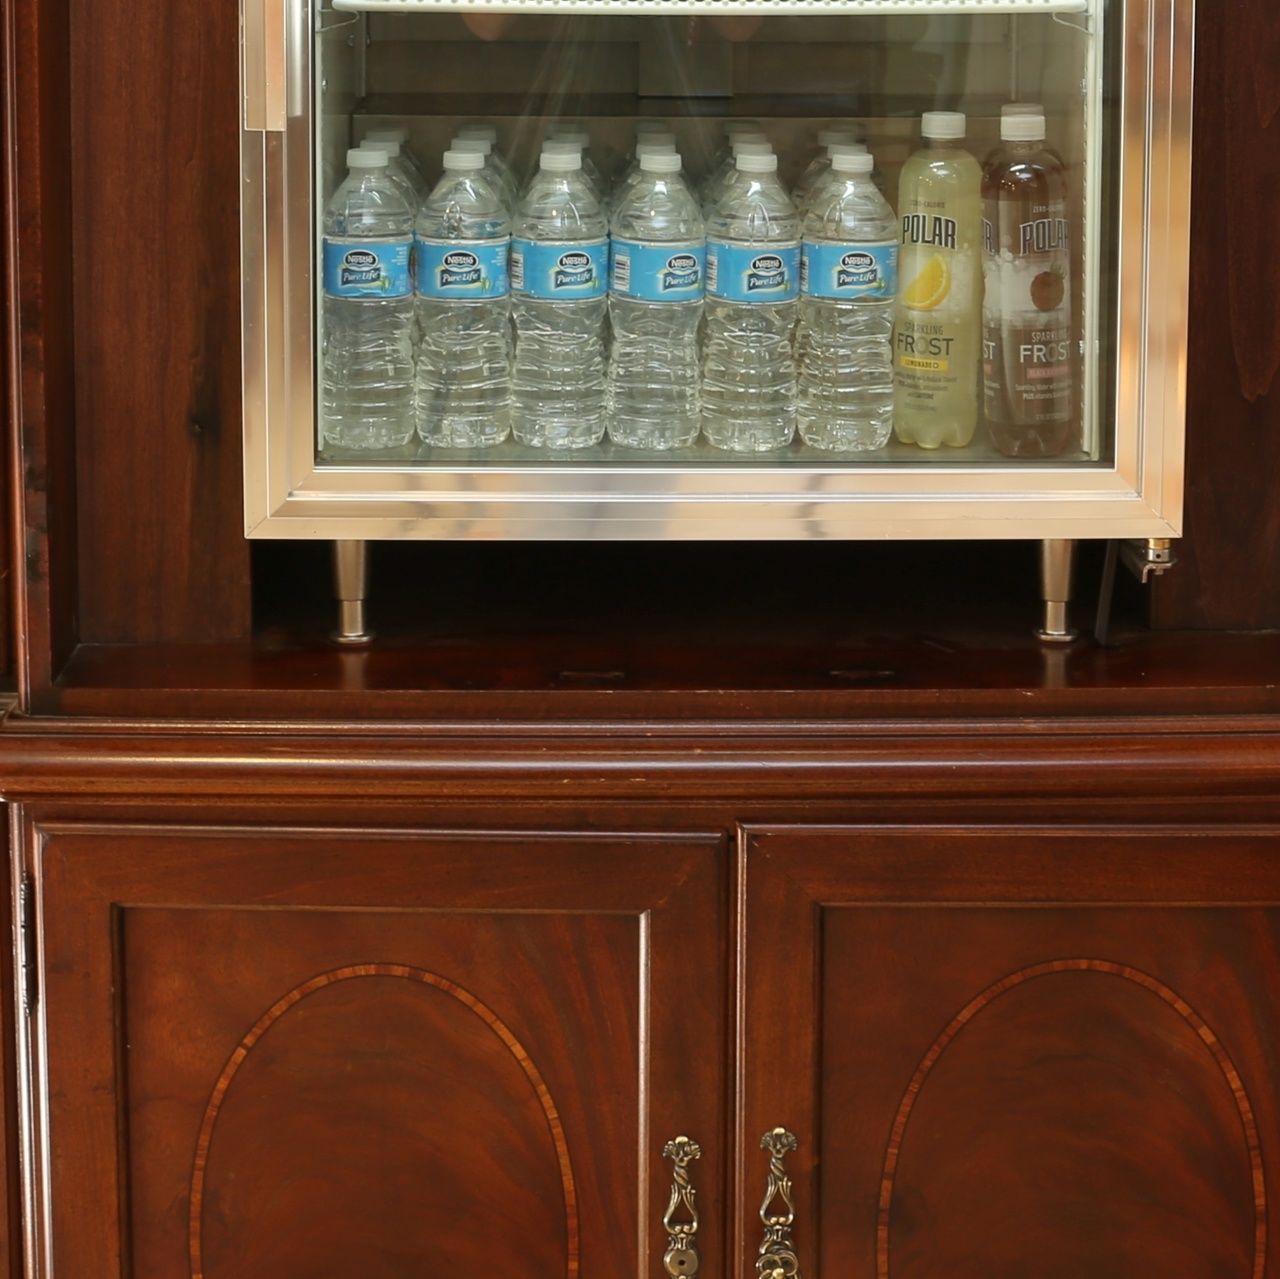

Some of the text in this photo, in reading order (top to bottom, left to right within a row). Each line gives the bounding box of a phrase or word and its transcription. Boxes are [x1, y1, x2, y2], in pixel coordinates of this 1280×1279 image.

[901, 213, 957, 250] POLAR
[343, 269, 379, 282] Pure Life
[442, 270, 480, 283] Pure Life
[557, 272, 591, 285] Pure Life
[665, 274, 697, 286] Pure Life
[749, 275, 783, 287] Pure Life
[839, 271, 876, 284] Pure Life
[896, 332, 955, 356] FROST
